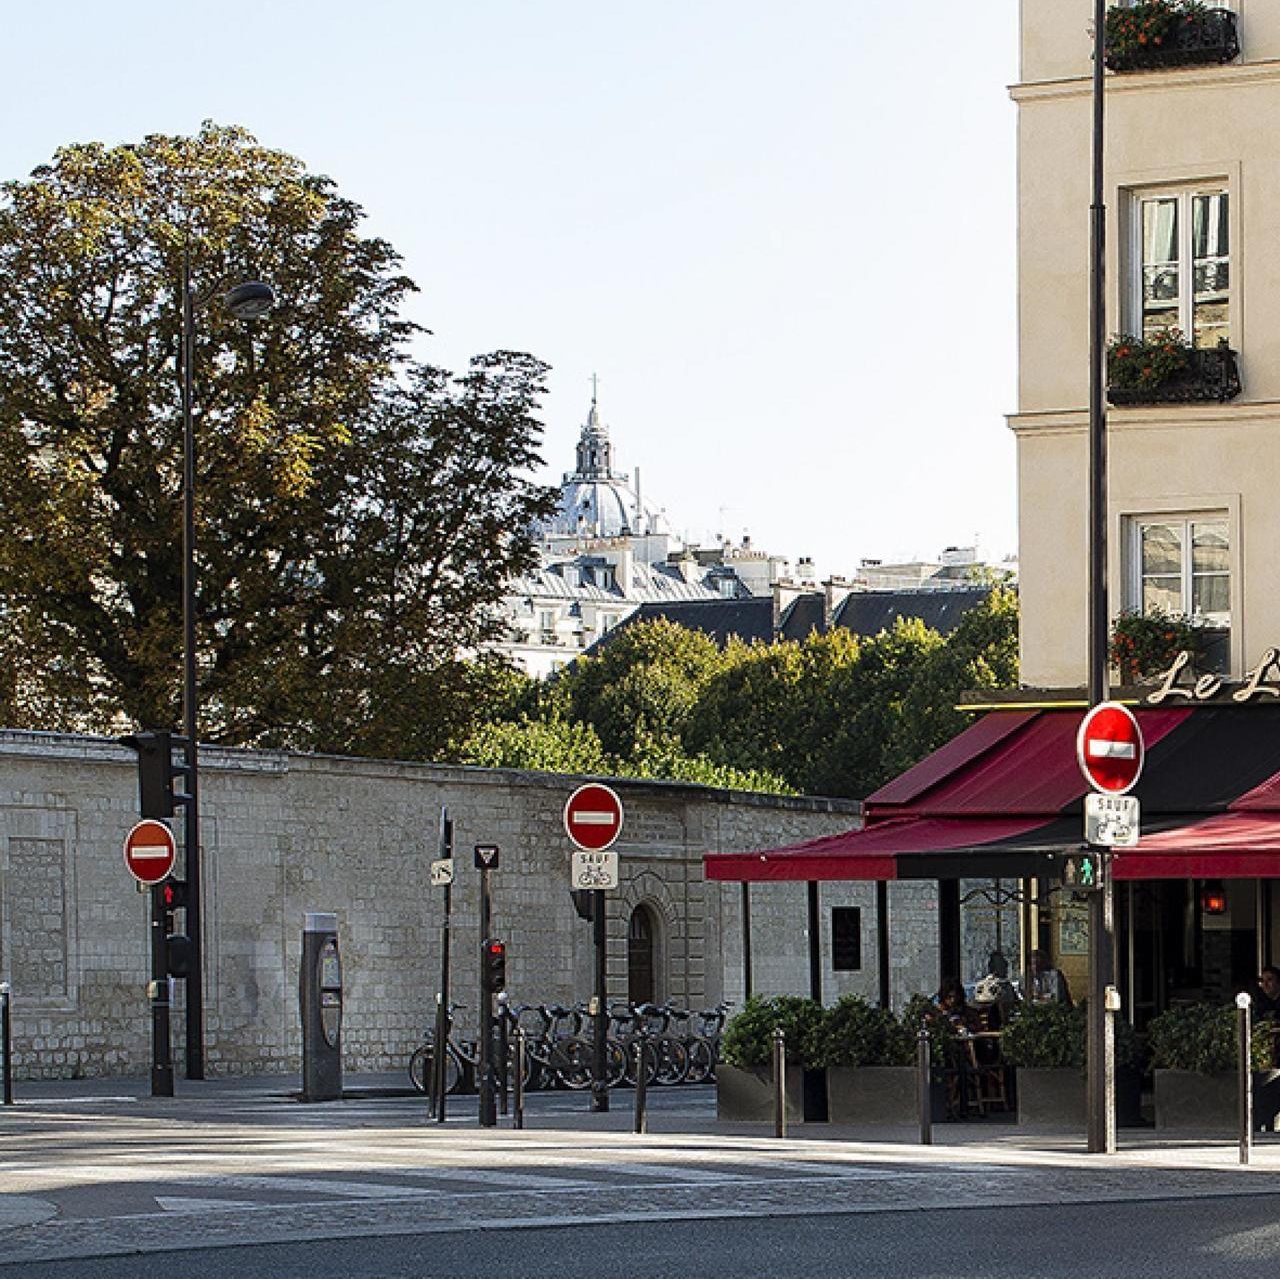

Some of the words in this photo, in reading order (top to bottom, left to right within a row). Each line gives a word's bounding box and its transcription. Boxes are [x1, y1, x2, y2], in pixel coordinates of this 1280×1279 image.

[1147, 650, 1221, 704] Le
[1098, 798, 1130, 811] SAUF
[580, 854, 610, 863] SAUF
